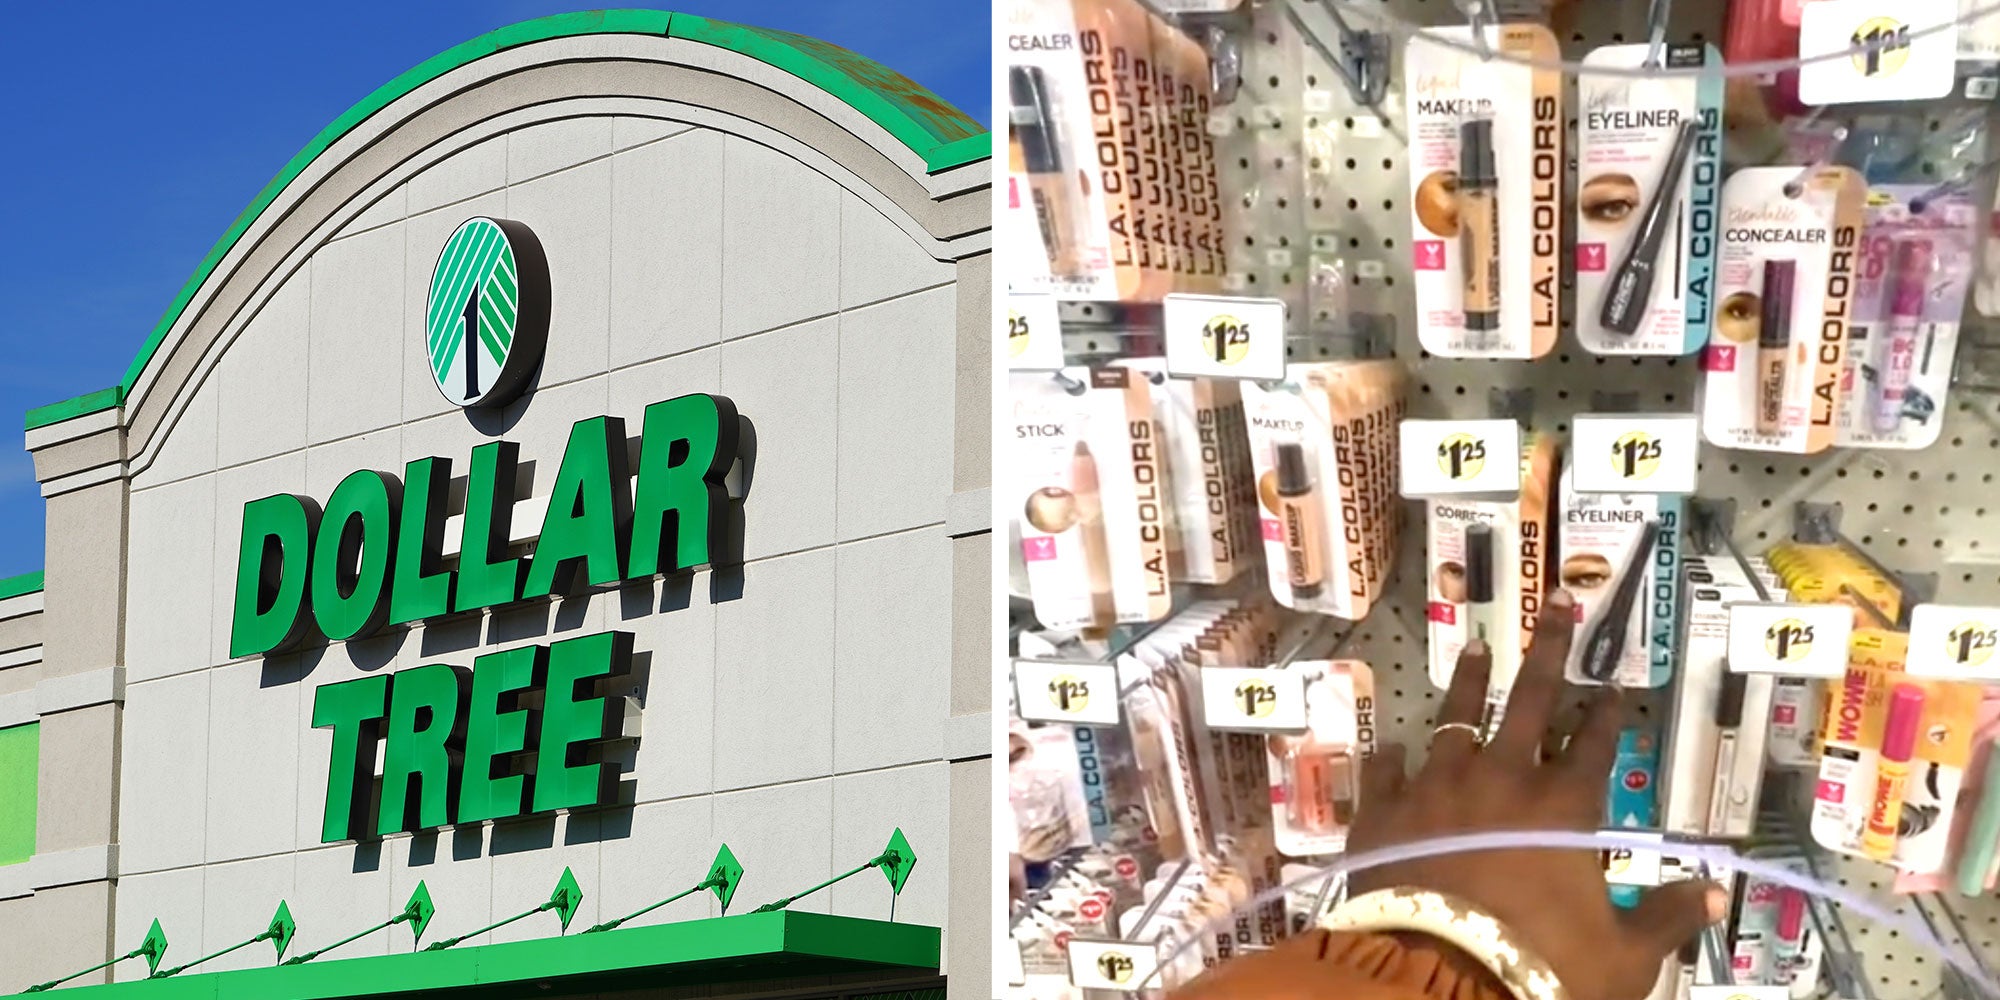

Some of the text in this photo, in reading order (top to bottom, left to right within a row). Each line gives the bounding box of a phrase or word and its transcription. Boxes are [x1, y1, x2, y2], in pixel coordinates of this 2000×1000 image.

[1081, 29, 1134, 267] L.A. COLORS
[1588, 109, 1680, 130] EYELINER
[1533, 95, 1556, 327] L.A. COLORS
[1687, 107, 1718, 325] L.A. COLORS
[1726, 228, 1826, 243] CONCEALER
[1811, 225, 1855, 427] L.A. COLORS
[1016, 424, 1065, 438] STICK
[1130, 420, 1166, 597] L.A. COLORS
[1197, 408, 1232, 563] L.A. COLORS
[1333, 424, 1367, 598] L.A. COLORS
[230, 393, 738, 660] DOLLAR
[1520, 520, 1539, 632] COLORS
[1567, 510, 1645, 523] EYELINER
[1652, 620, 1671, 667] L.A.
[1836, 667, 1867, 741] WOWIE
[311, 630, 634, 844] TREE
